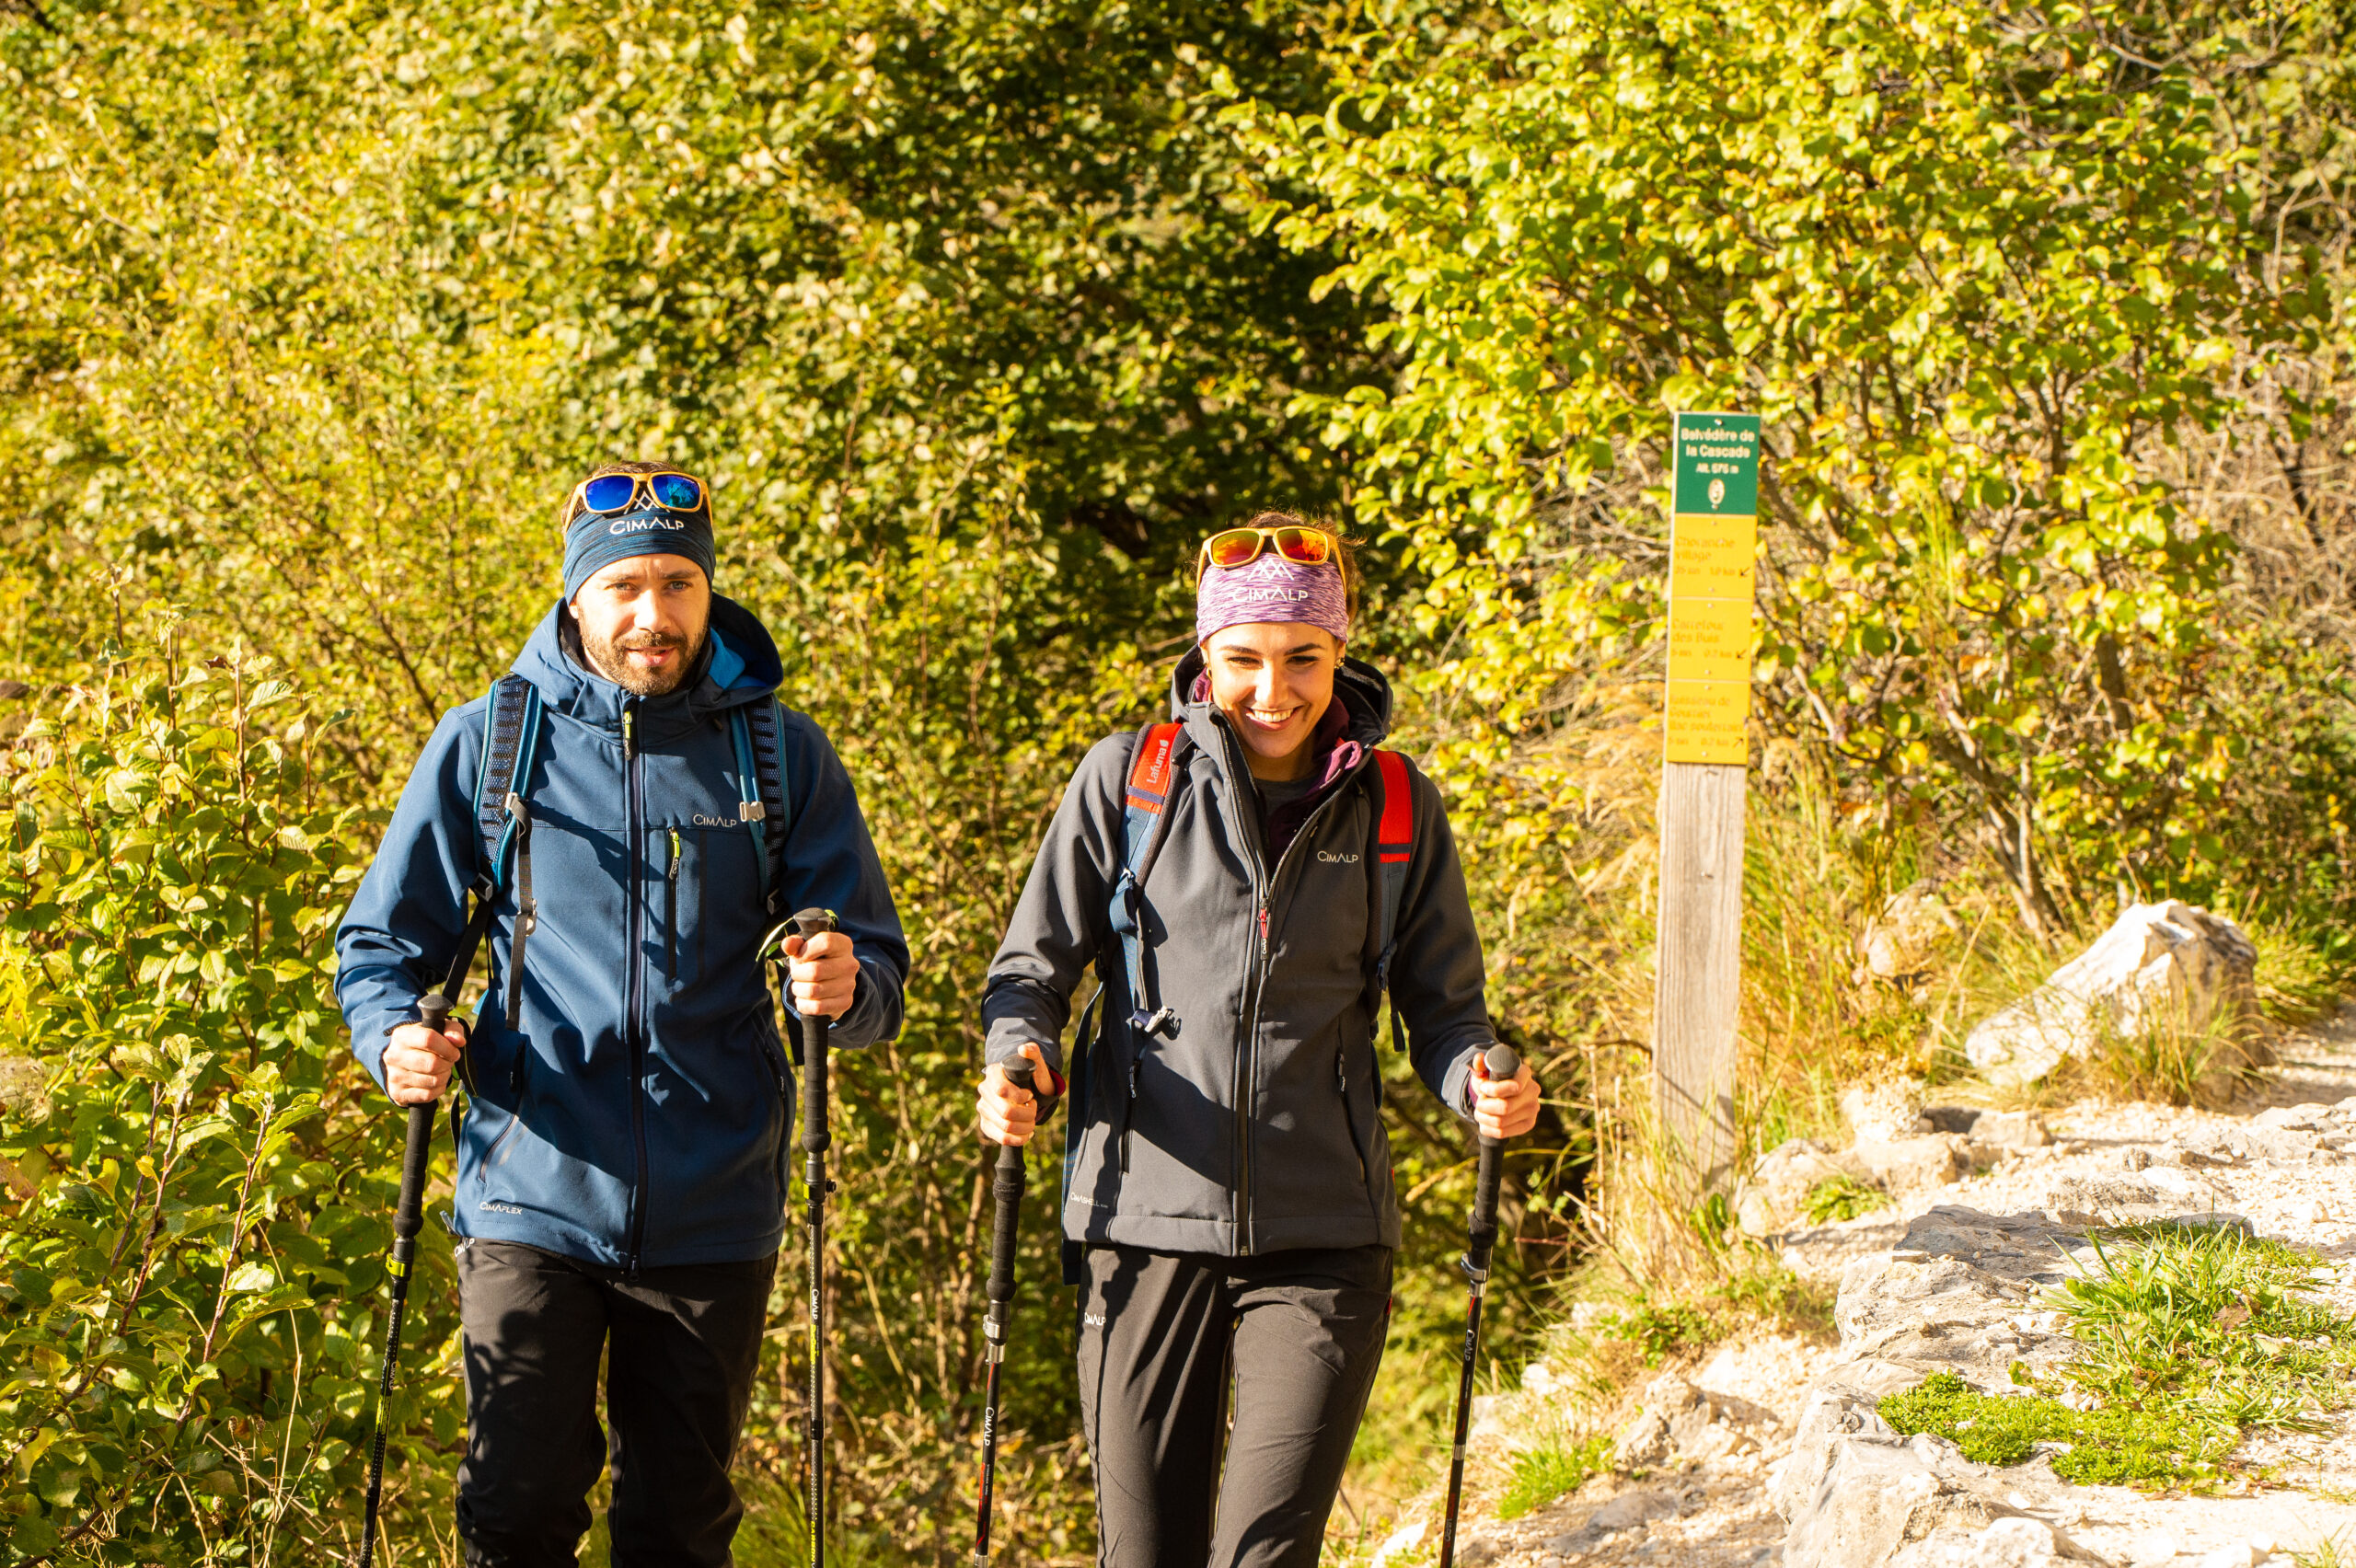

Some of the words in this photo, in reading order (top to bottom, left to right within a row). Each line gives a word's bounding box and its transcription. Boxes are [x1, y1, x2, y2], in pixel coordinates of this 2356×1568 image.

[1680, 427, 1738, 442] Belvédère
[1739, 429, 1755, 443] de
[1686, 444, 1697, 457] la
[1700, 444, 1750, 458] Cascade
[609, 516, 685, 536] CIMALP
[1233, 587, 1309, 603] CIMALP
[1146, 746, 1167, 784] Lafuma
